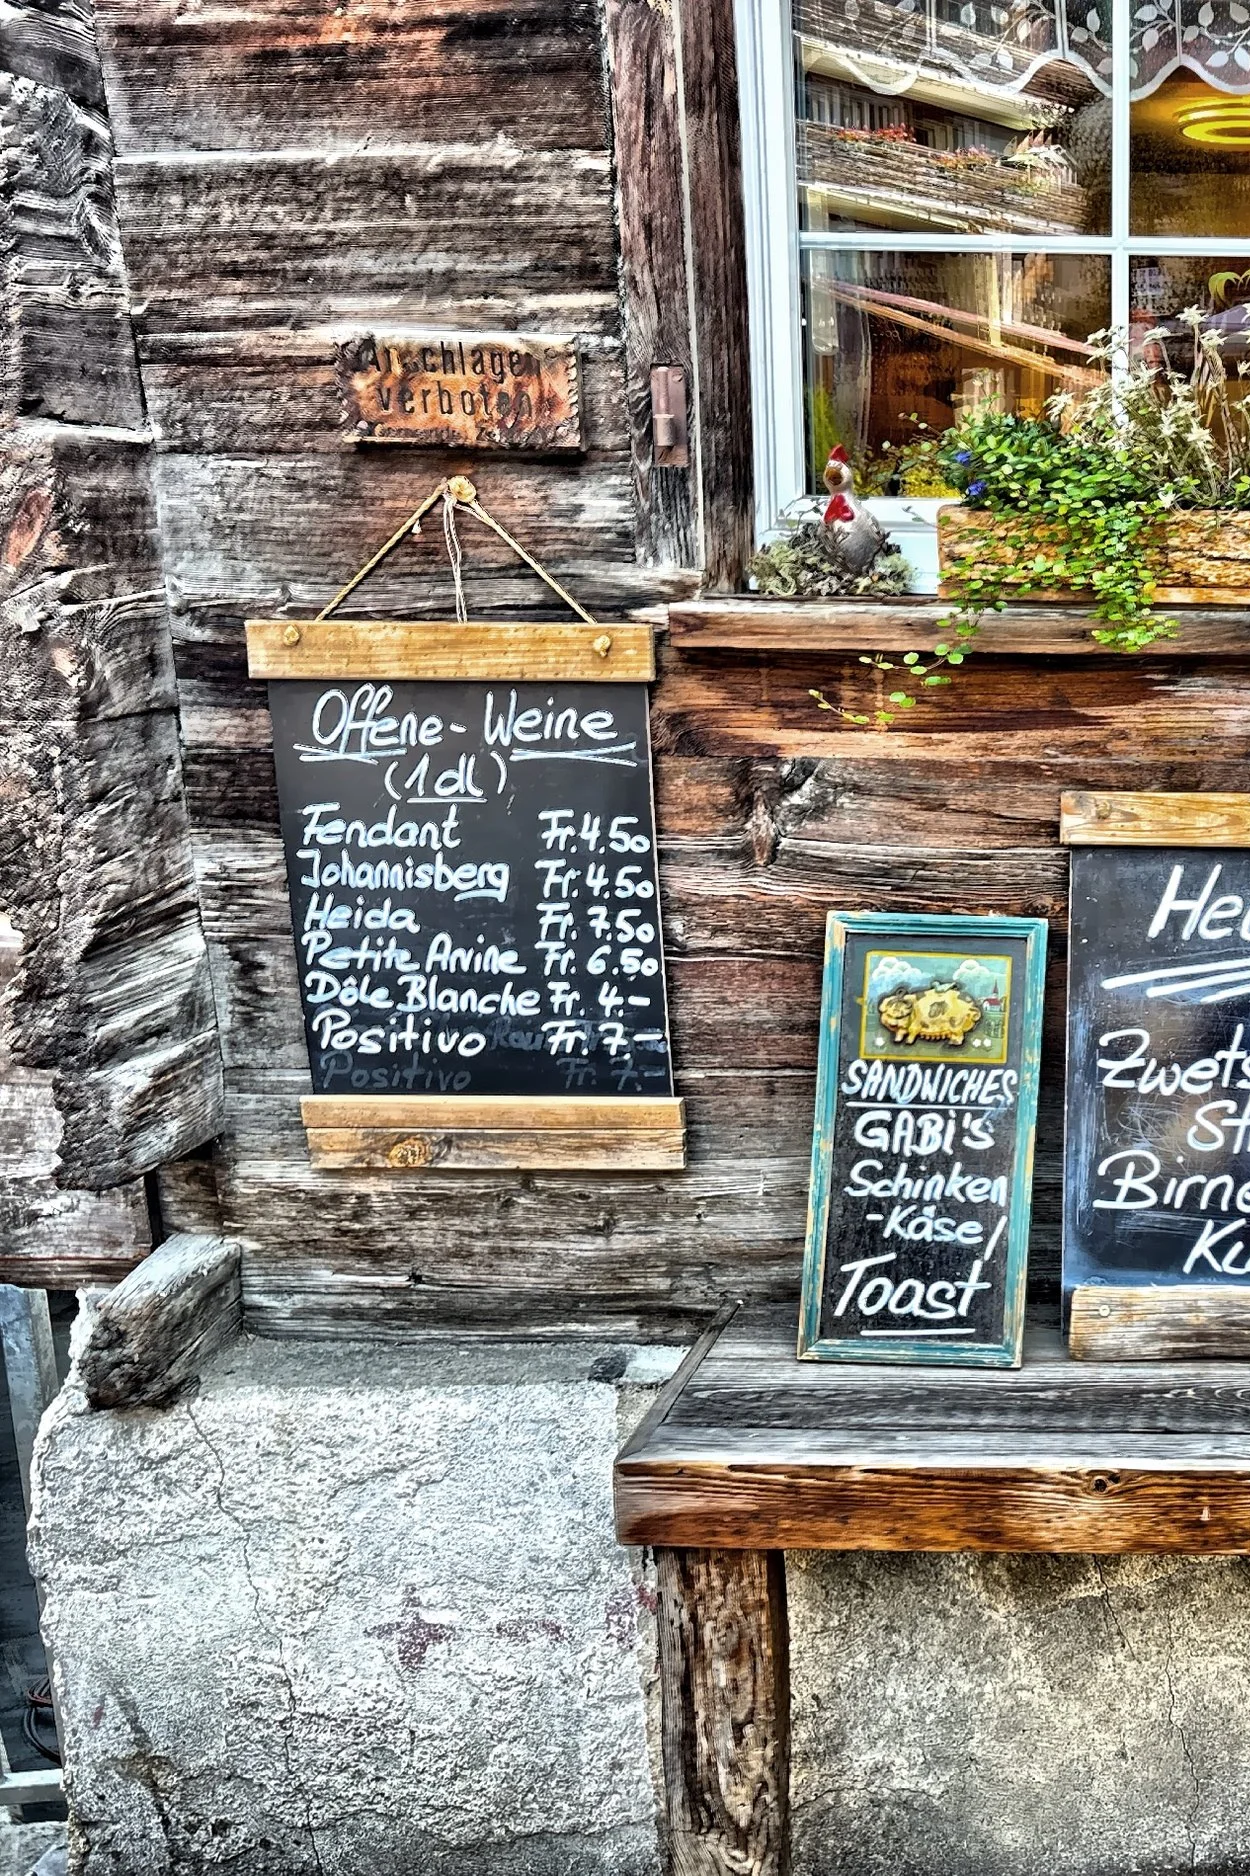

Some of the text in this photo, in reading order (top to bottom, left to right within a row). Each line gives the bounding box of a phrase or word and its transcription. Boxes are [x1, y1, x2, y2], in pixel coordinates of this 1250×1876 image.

[484, 689, 618, 747] Weine
[302, 802, 462, 849] Fendant
[296, 848, 510, 902] Johannisberg
[303, 891, 421, 934] Heida
[301, 929, 420, 972] Petite
[425, 930, 527, 975] Arvine
[304, 970, 395, 1009] Dôle
[396, 973, 541, 1017] Blanche
[312, 1008, 487, 1058] Positivo
[841, 1058, 1018, 1106] SANDWICHES
[844, 1157, 1007, 1208] Schinken
[834, 1252, 992, 1320] Toast
